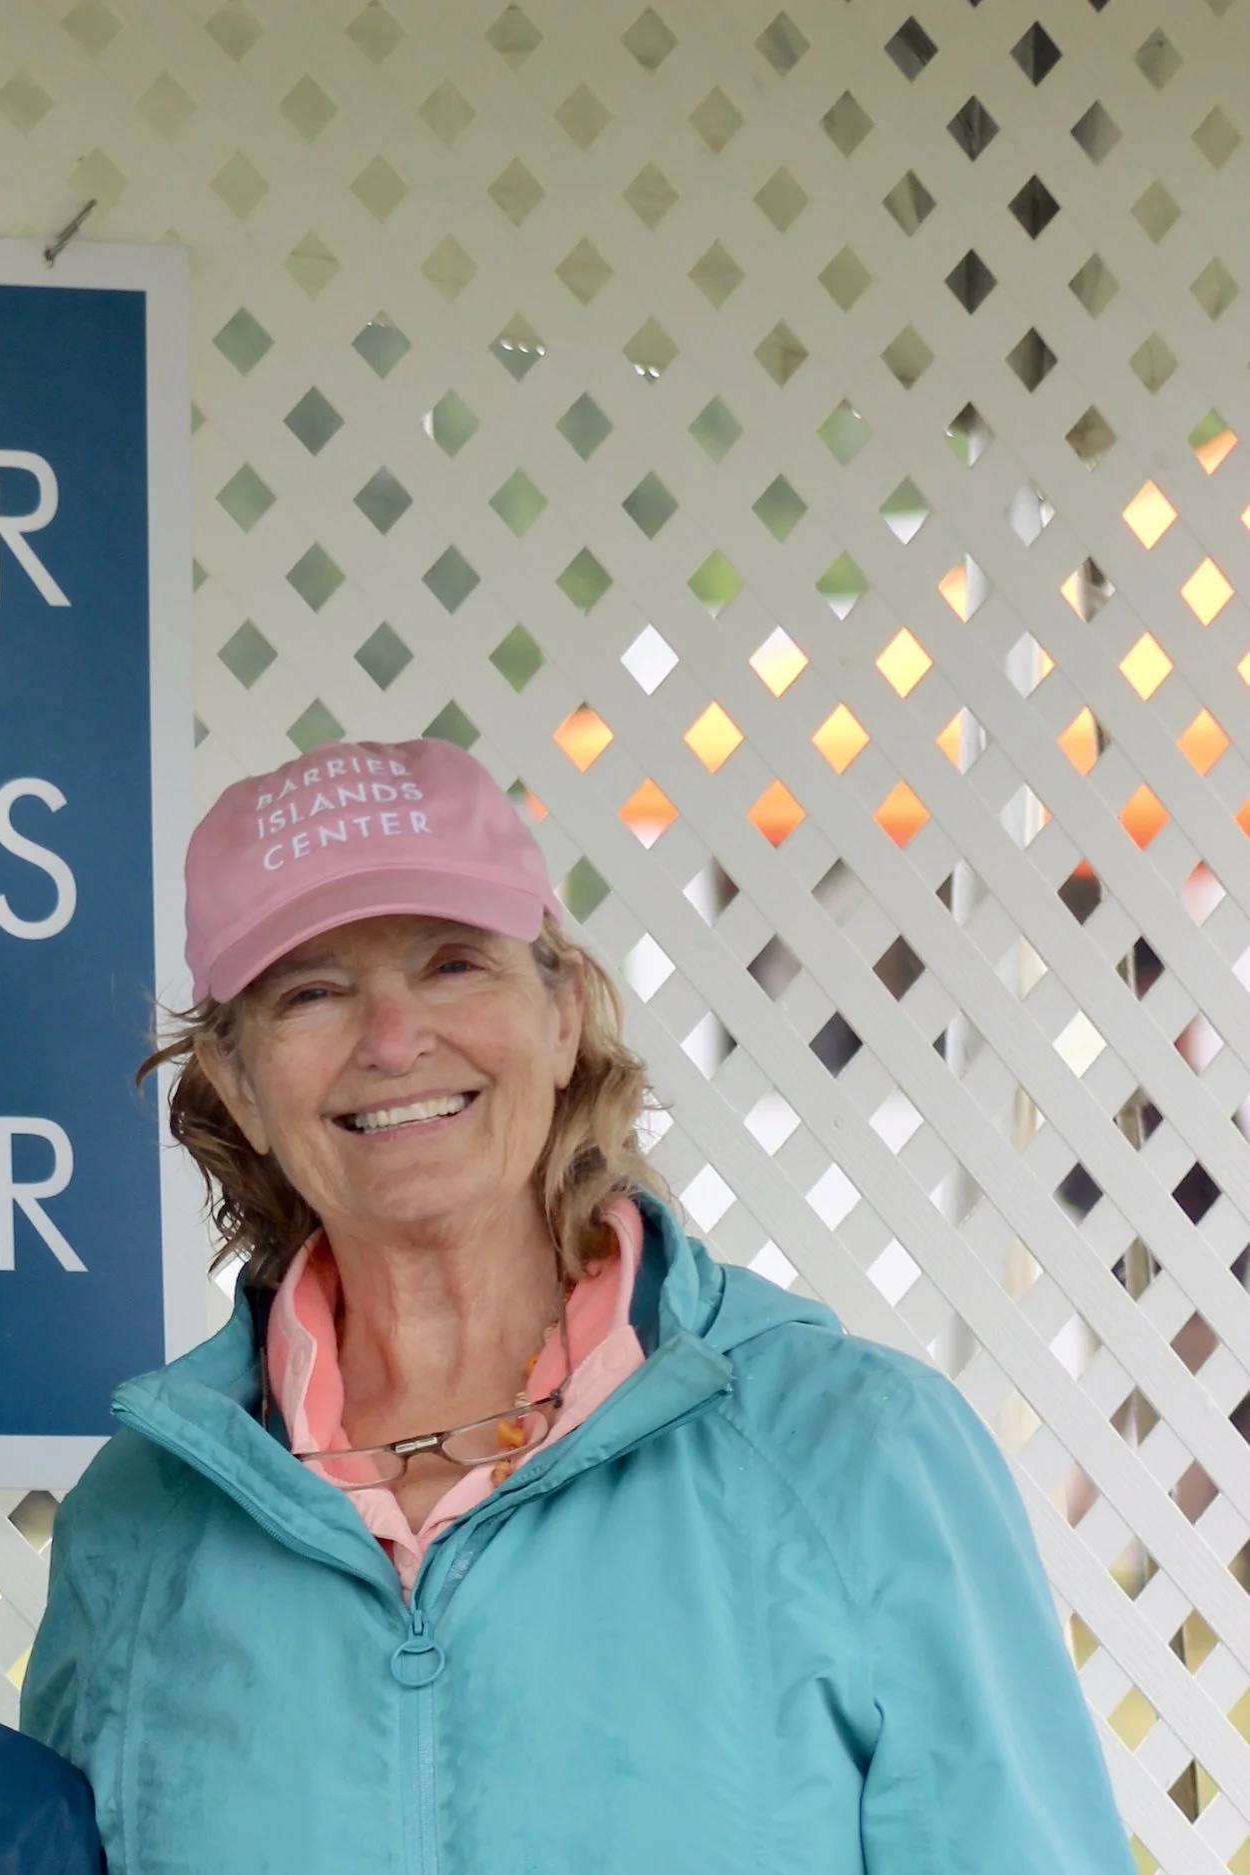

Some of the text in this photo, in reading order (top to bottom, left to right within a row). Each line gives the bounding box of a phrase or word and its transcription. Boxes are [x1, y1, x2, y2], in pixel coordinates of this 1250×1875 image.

[256, 757, 412, 811] BARRIER
[257, 781, 424, 839] ISLANDS
[262, 810, 432, 872] CENTER
